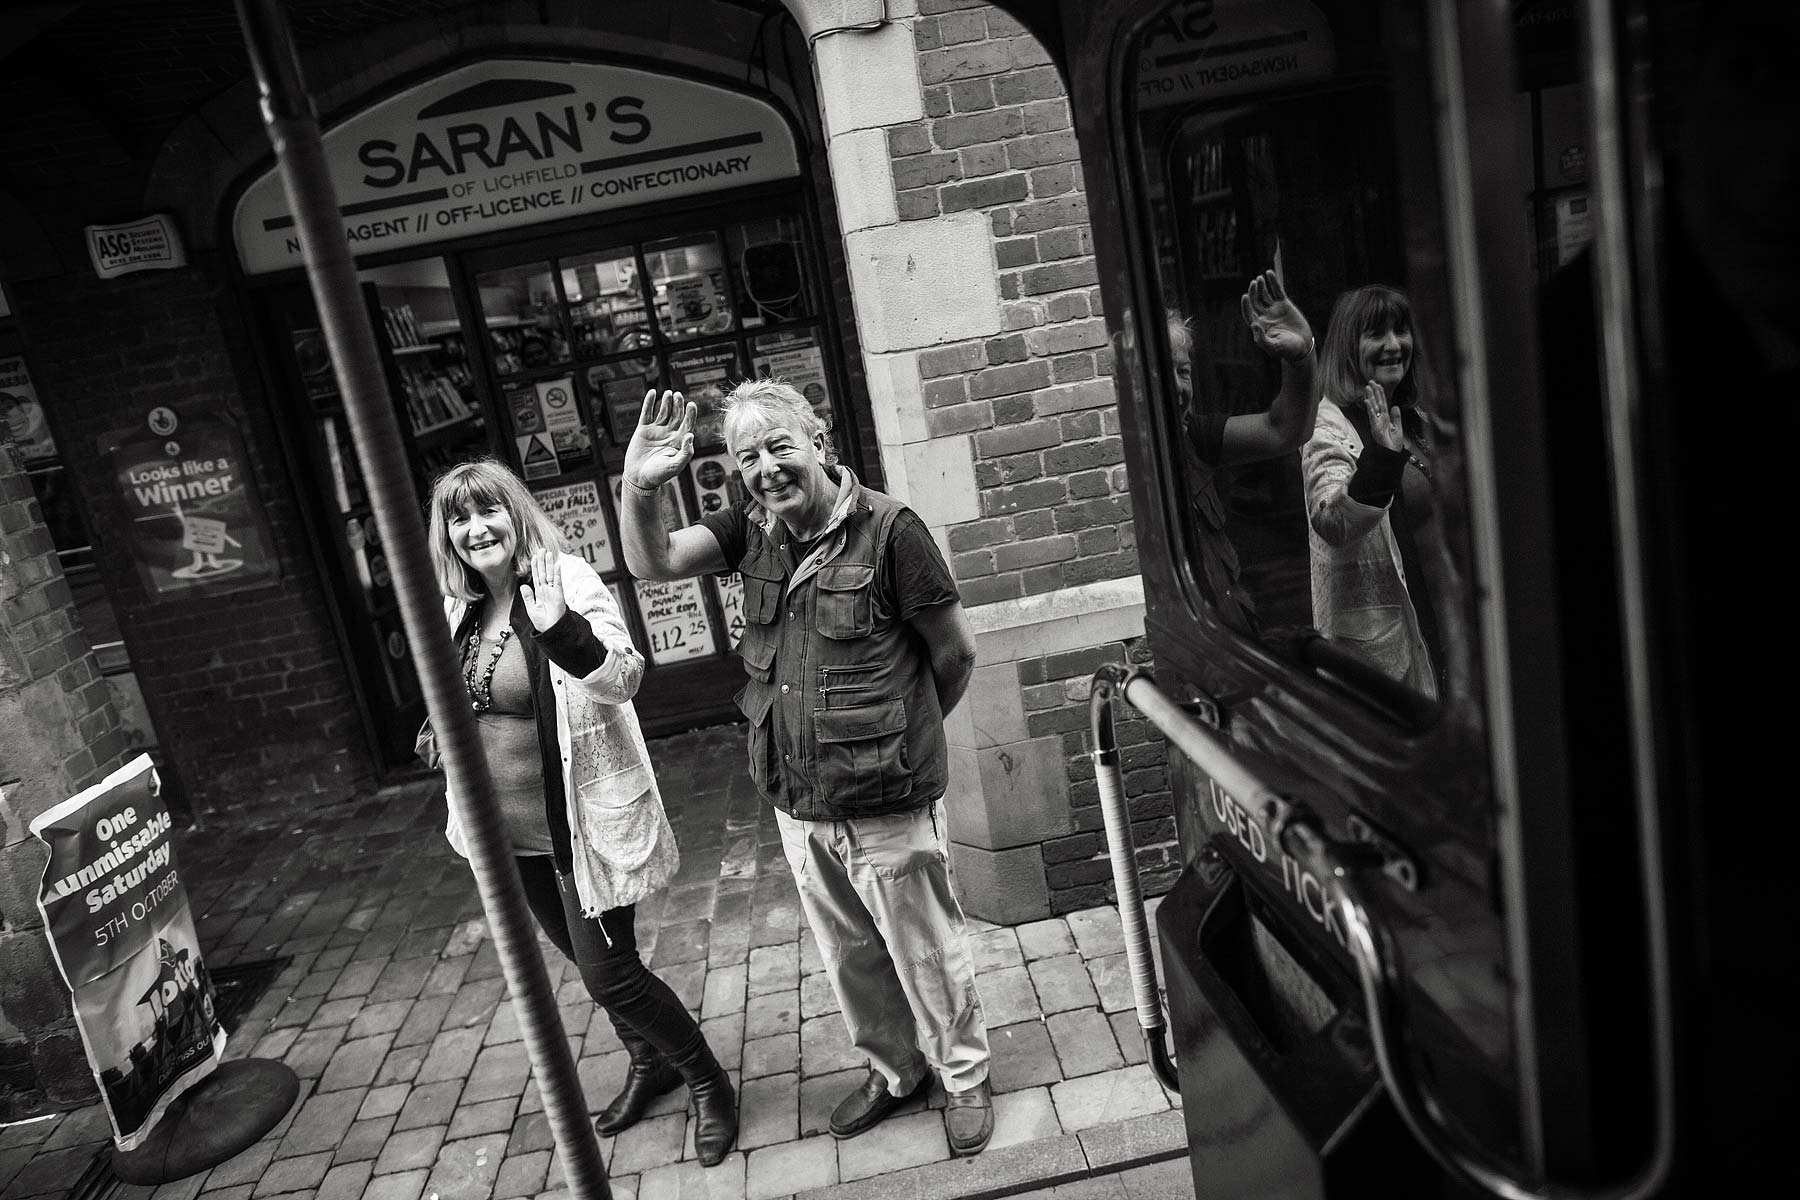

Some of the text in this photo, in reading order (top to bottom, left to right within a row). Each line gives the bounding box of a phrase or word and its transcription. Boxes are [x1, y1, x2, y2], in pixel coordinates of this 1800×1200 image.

[358, 96, 651, 188] SARAN'S
[452, 163, 578, 198] OF LICHFIELD
[286, 217, 410, 254] NAGENT
[436, 189, 566, 226] OFF-LICENCE
[590, 155, 752, 198] CONFECTIONARY
[99, 232, 131, 259] ASG
[670, 352, 735, 370] Thanks to you
[129, 457, 229, 485] Looks like a
[133, 474, 233, 508] Winner
[534, 483, 594, 503] SPECIAL OFFER
[567, 492, 595, 510] FALLS
[639, 585, 670, 600] PRINCE
[651, 626, 687, 653] £12
[96, 806, 138, 842] One
[53, 811, 172, 897] unmissable
[1209, 777, 1347, 949] USED TICK
[85, 840, 170, 914] Saturday
[94, 870, 179, 947] 5TH OCTOBER
